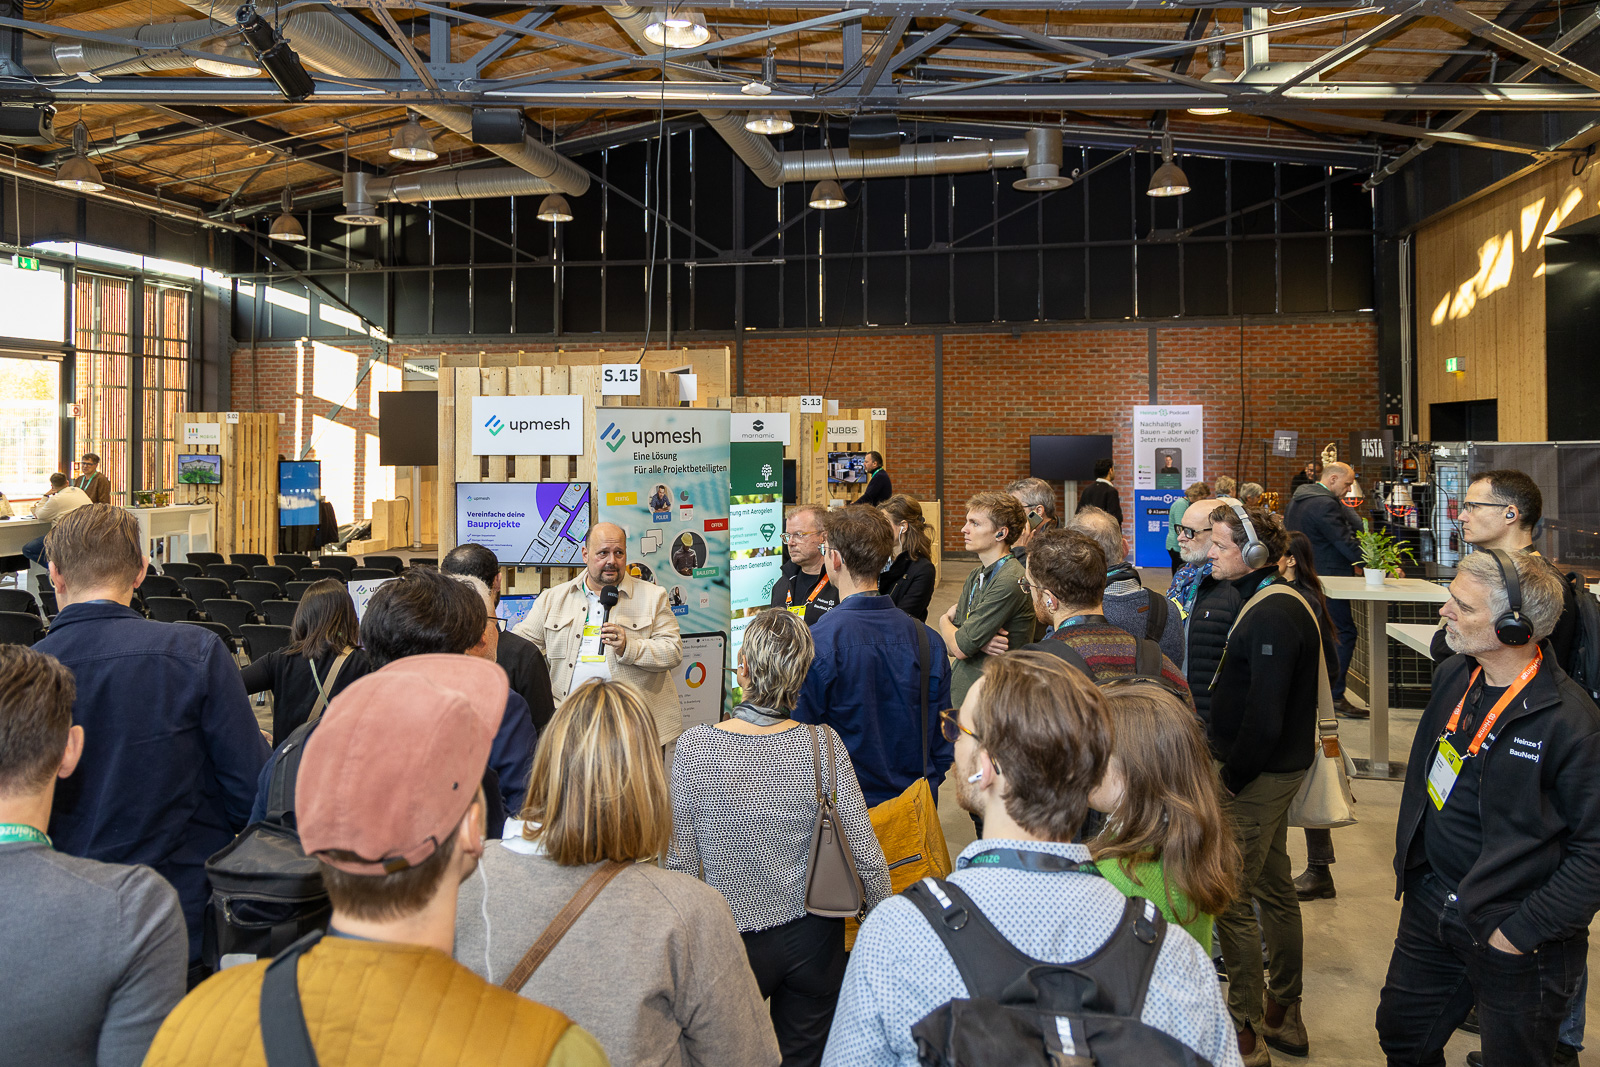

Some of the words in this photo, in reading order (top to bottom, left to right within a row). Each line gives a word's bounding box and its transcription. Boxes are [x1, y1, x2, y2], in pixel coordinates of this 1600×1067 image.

[604, 369, 638, 382] S.15
[802, 398, 821, 406] S.13
[509, 417, 570, 433] upmesh
[632, 427, 702, 448] upmesh
[1361, 438, 1384, 458] PASTA
[633, 452, 650, 461] Eine
[652, 451, 678, 461] Lösung
[634, 465, 647, 474] Für
[648, 465, 661, 474] alle
[663, 464, 728, 475] Projektbeteiligten
[755, 481, 774, 489] aerogel
[751, 508, 773, 516] Aerogelen
[467, 520, 521, 530] Bauprojekte
[748, 561, 773, 569] Generation
[1520, 662, 1539, 681] Heinze
[1477, 719, 1492, 739] Heinze
[1513, 736, 1537, 748] Heinze
[1509, 748, 1537, 761] BauNetz
